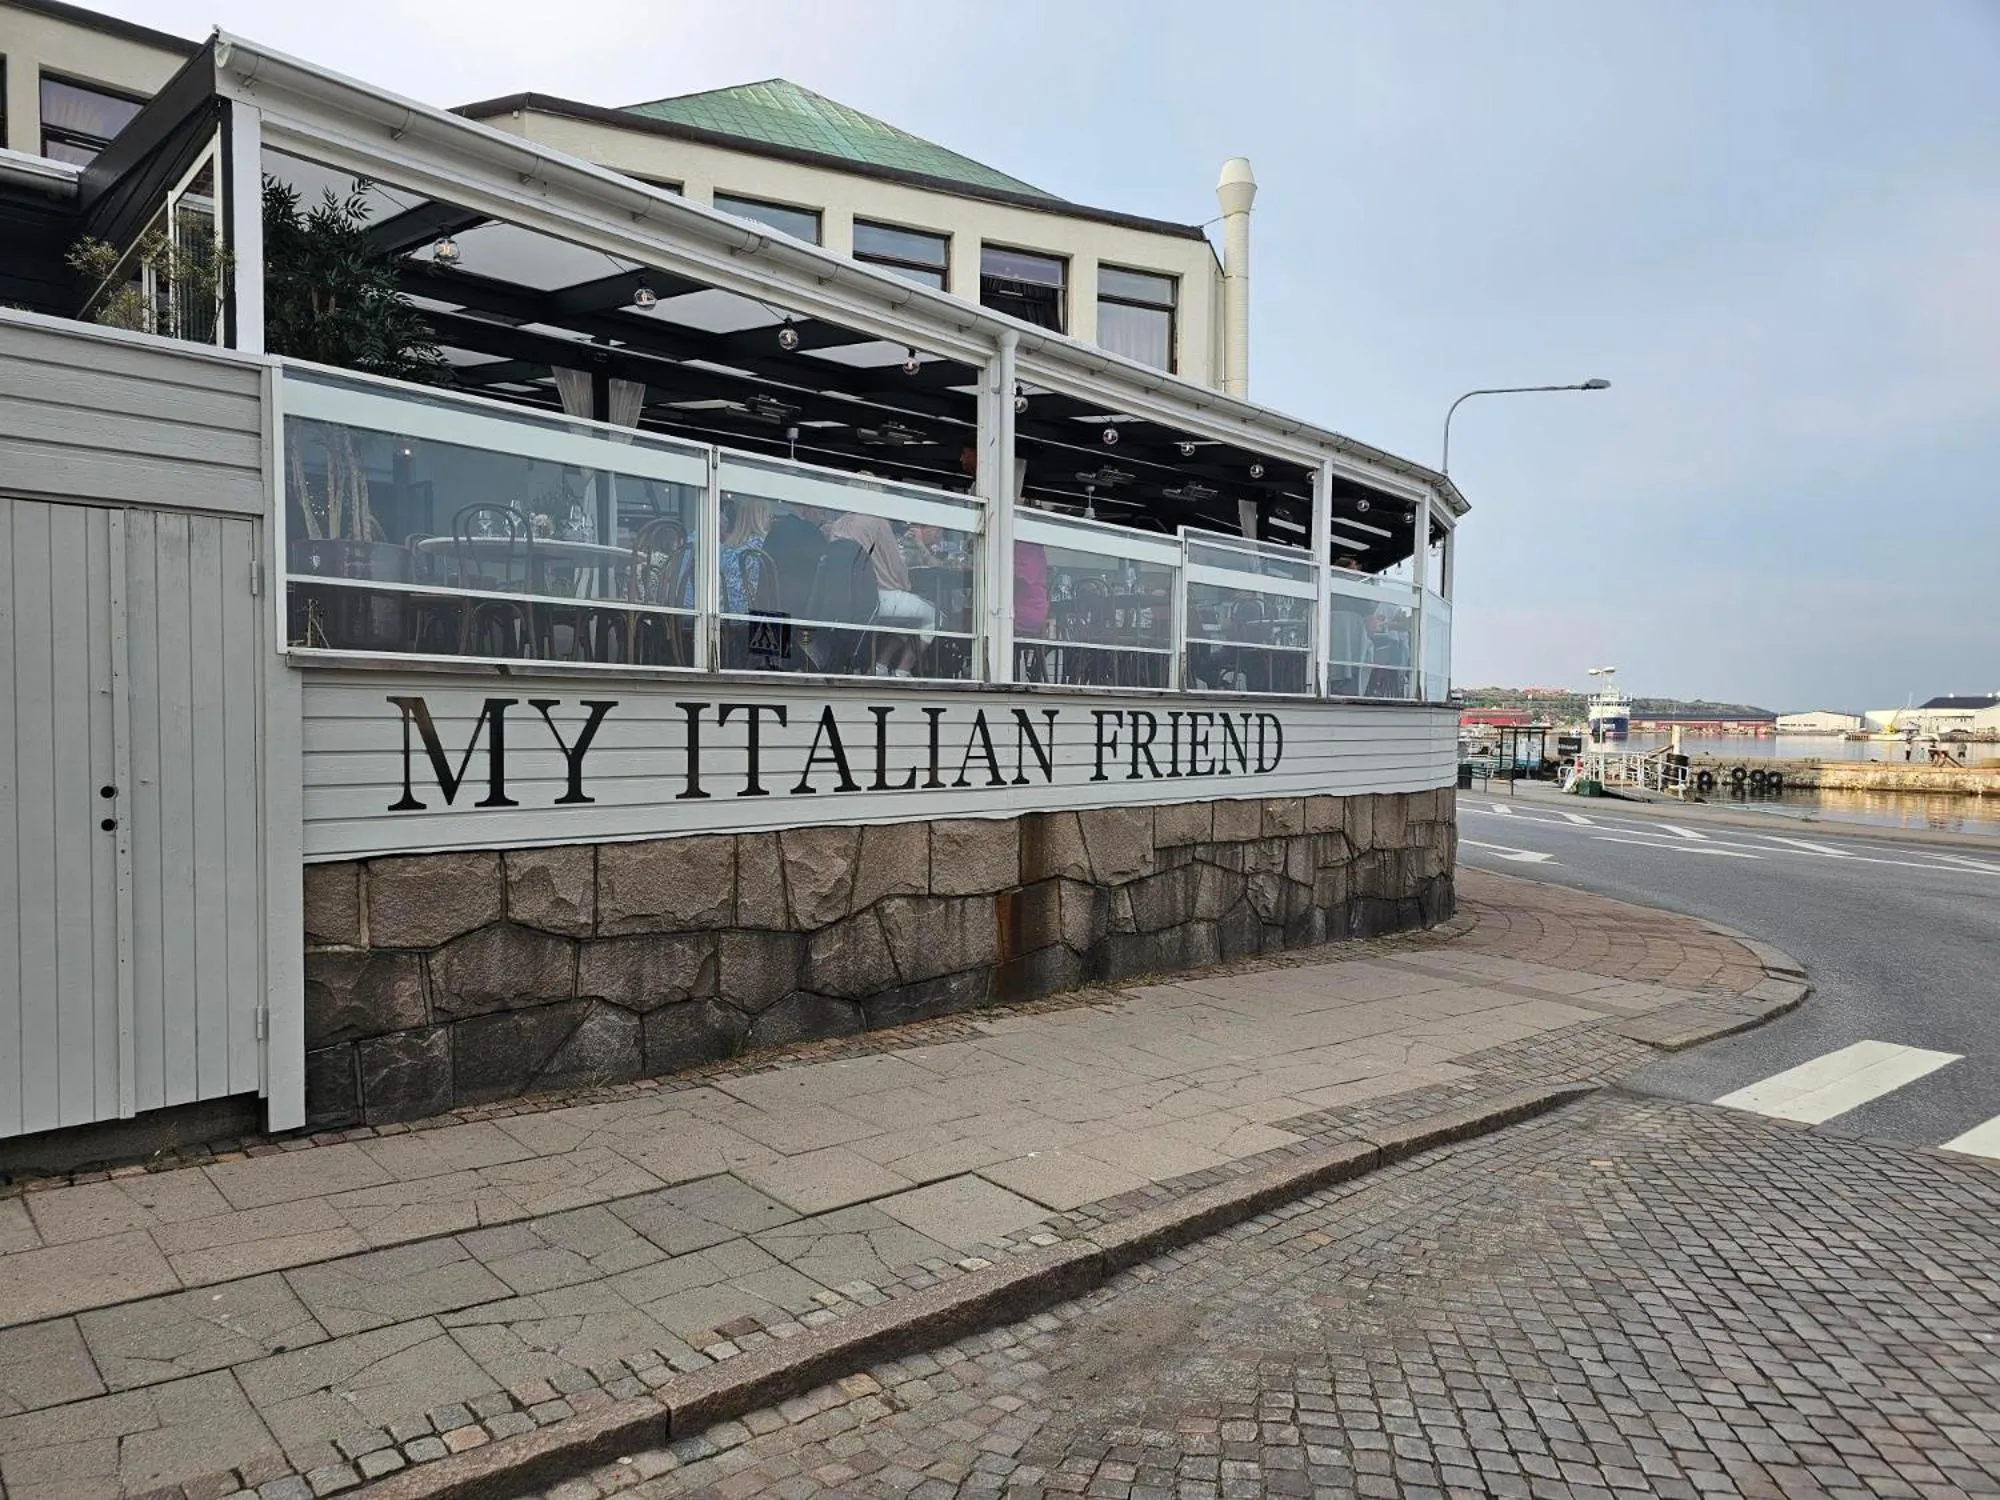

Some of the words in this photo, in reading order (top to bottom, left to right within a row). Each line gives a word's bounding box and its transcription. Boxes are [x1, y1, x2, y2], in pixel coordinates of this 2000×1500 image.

[387, 696, 619, 810] MY
[675, 702, 1059, 798] ITALIAN
[1090, 710, 1283, 782] FRIEND
